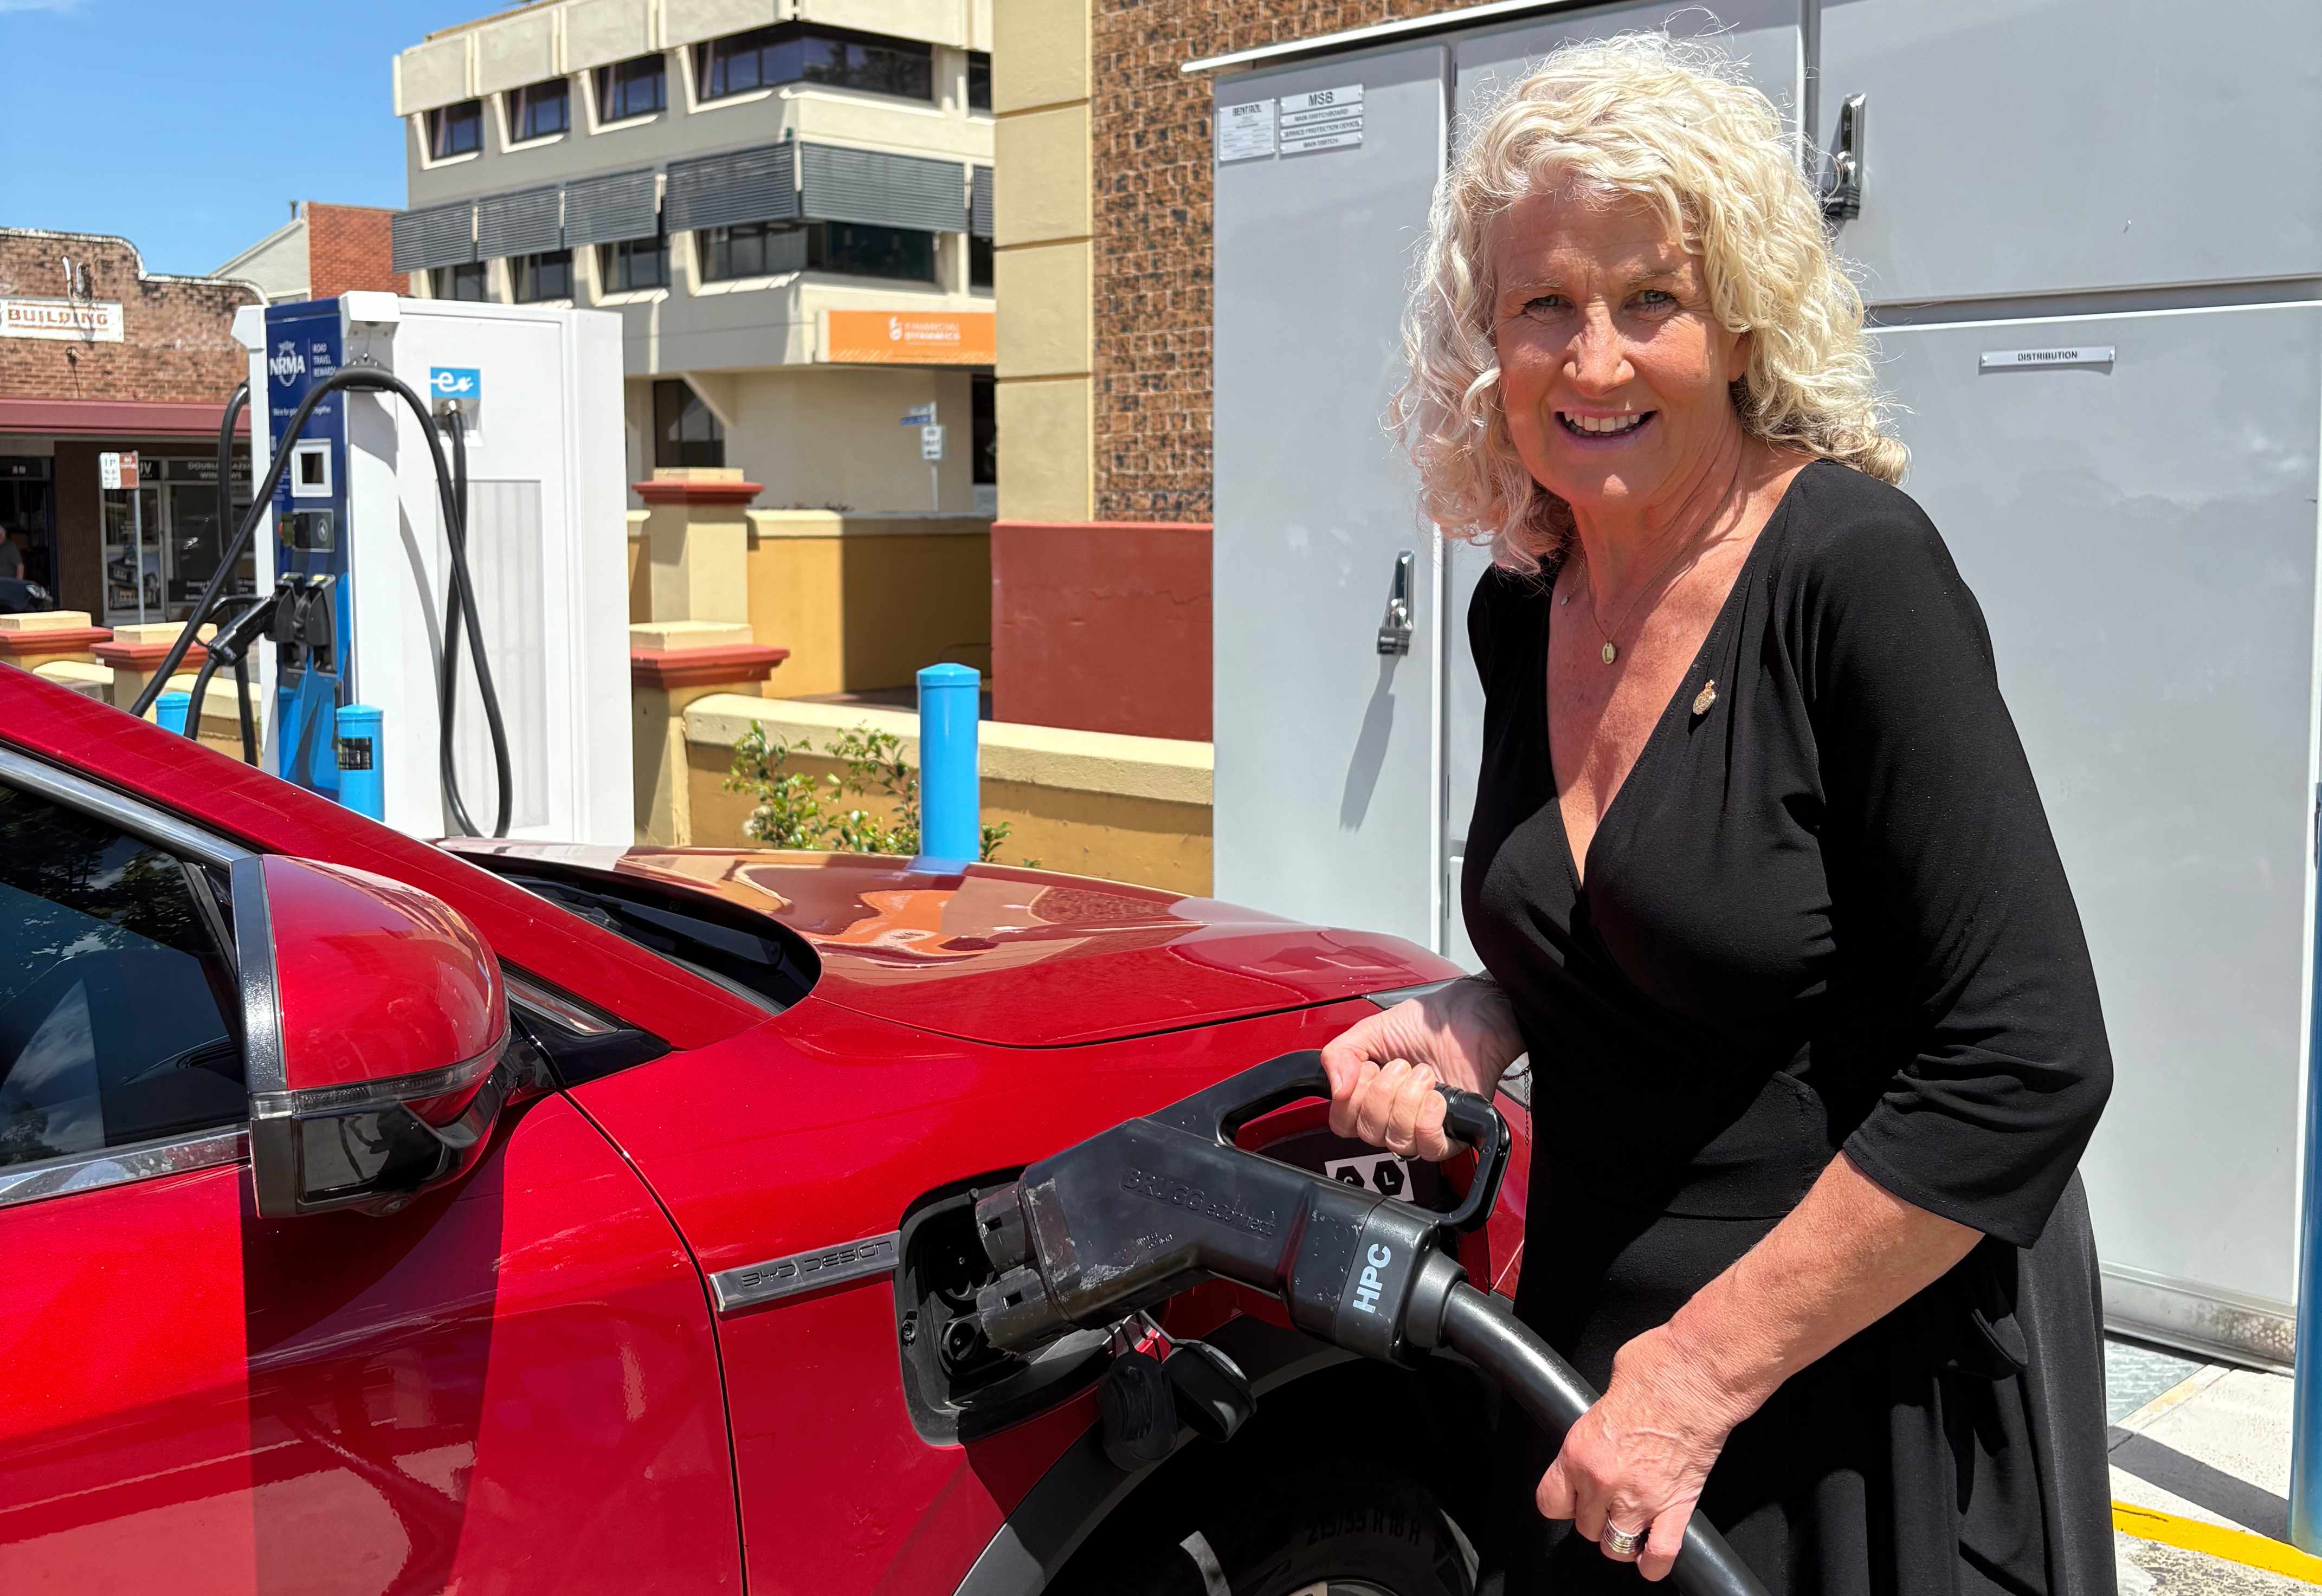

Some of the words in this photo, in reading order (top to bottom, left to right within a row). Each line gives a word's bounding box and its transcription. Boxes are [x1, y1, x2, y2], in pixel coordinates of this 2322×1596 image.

[1308, 91, 1335, 106] MSB
[1294, 113, 1307, 122] MAIN
[1308, 108, 1350, 120] SWITCHBOARD
[1305, 124, 1339, 135] PROTECTION
[1303, 140, 1317, 148] MAIN
[1317, 138, 1338, 147] SWITCH
[8, 308, 108, 325] BUILDING
[313, 354, 331, 365] TRAVEL
[2017, 351, 2078, 362] DISTRIBUTION
[269, 354, 306, 376] NRMA
[1383, 1172, 1395, 1186] L
[741, 1263, 797, 1287] BYD
[803, 1240, 894, 1272] DESIGN
[1352, 1243, 1391, 1314] HPC
